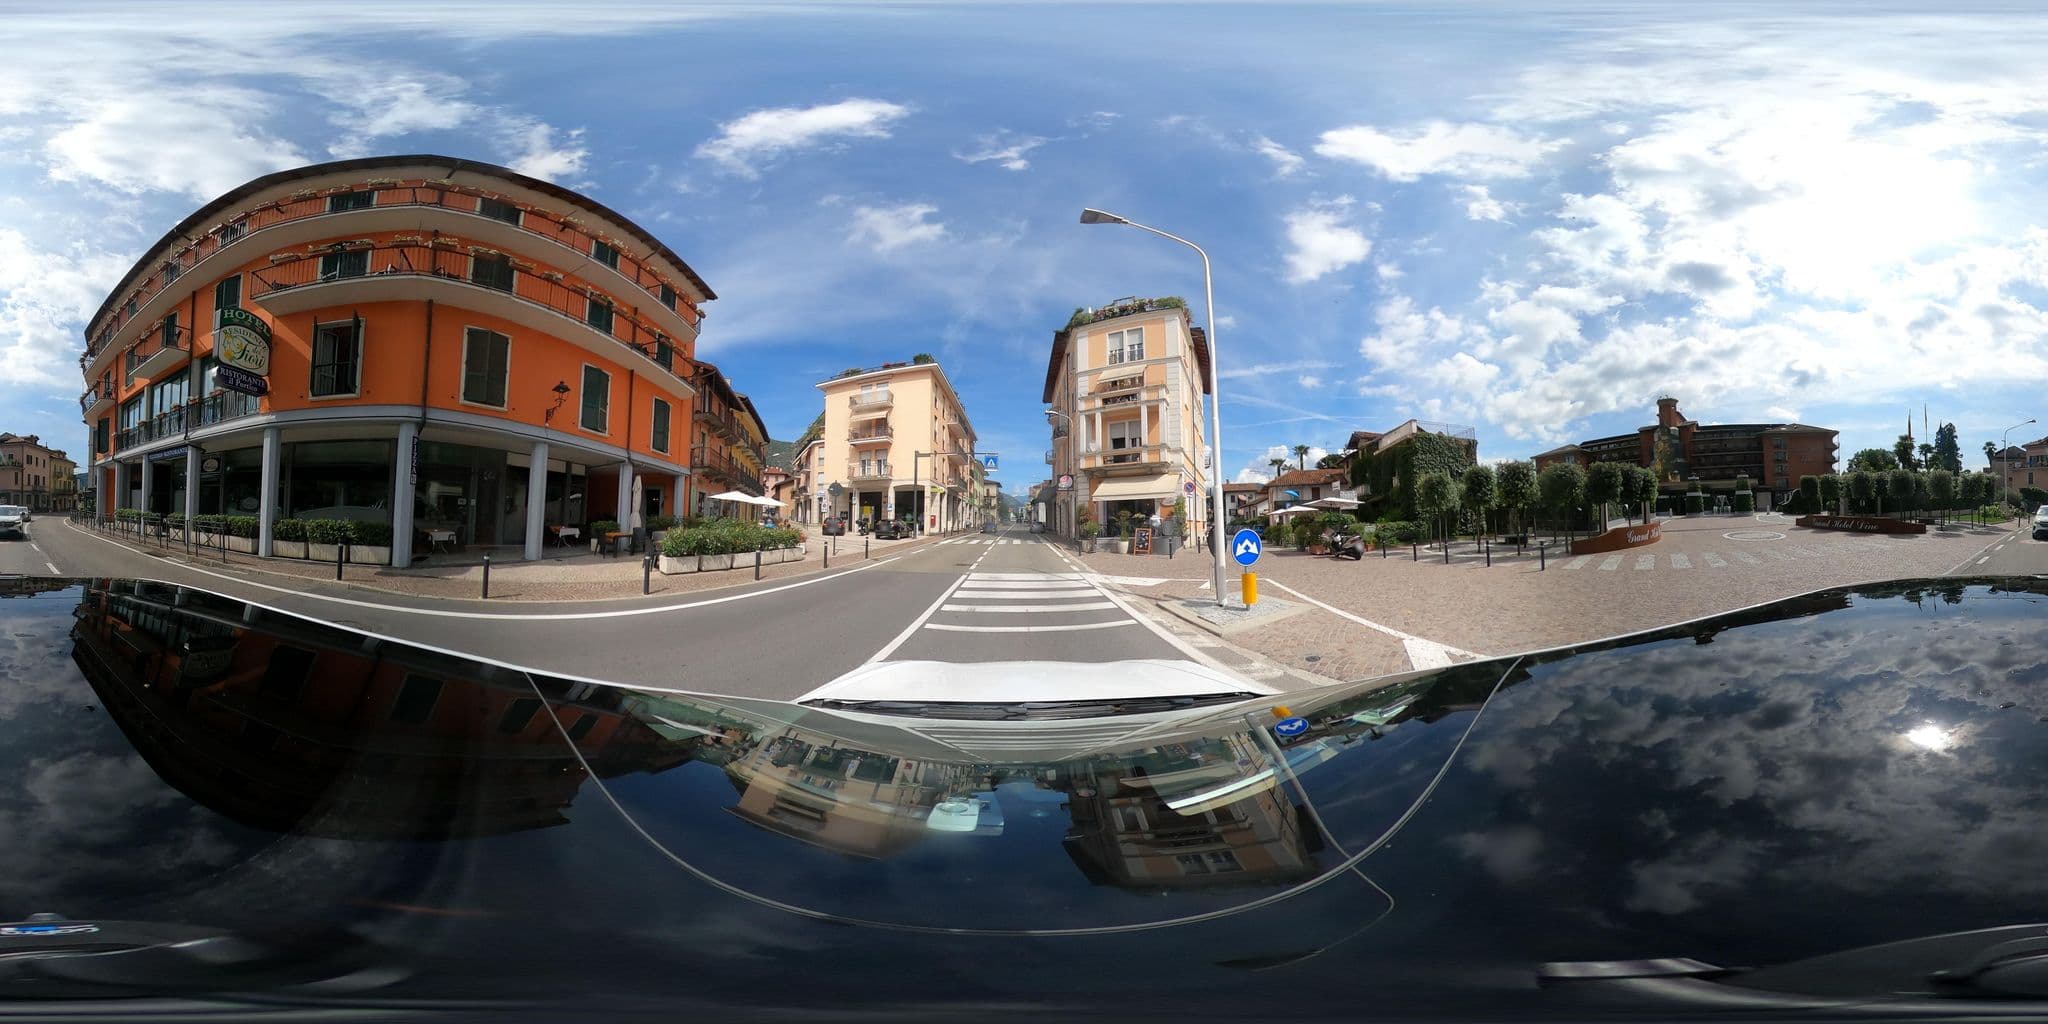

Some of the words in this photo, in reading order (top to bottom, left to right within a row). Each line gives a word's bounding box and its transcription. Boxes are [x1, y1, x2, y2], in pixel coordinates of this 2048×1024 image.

[223, 309, 271, 336] HOTEL
[220, 367, 265, 386] RISTORANTE
[1626, 529, 1649, 544] Grand
